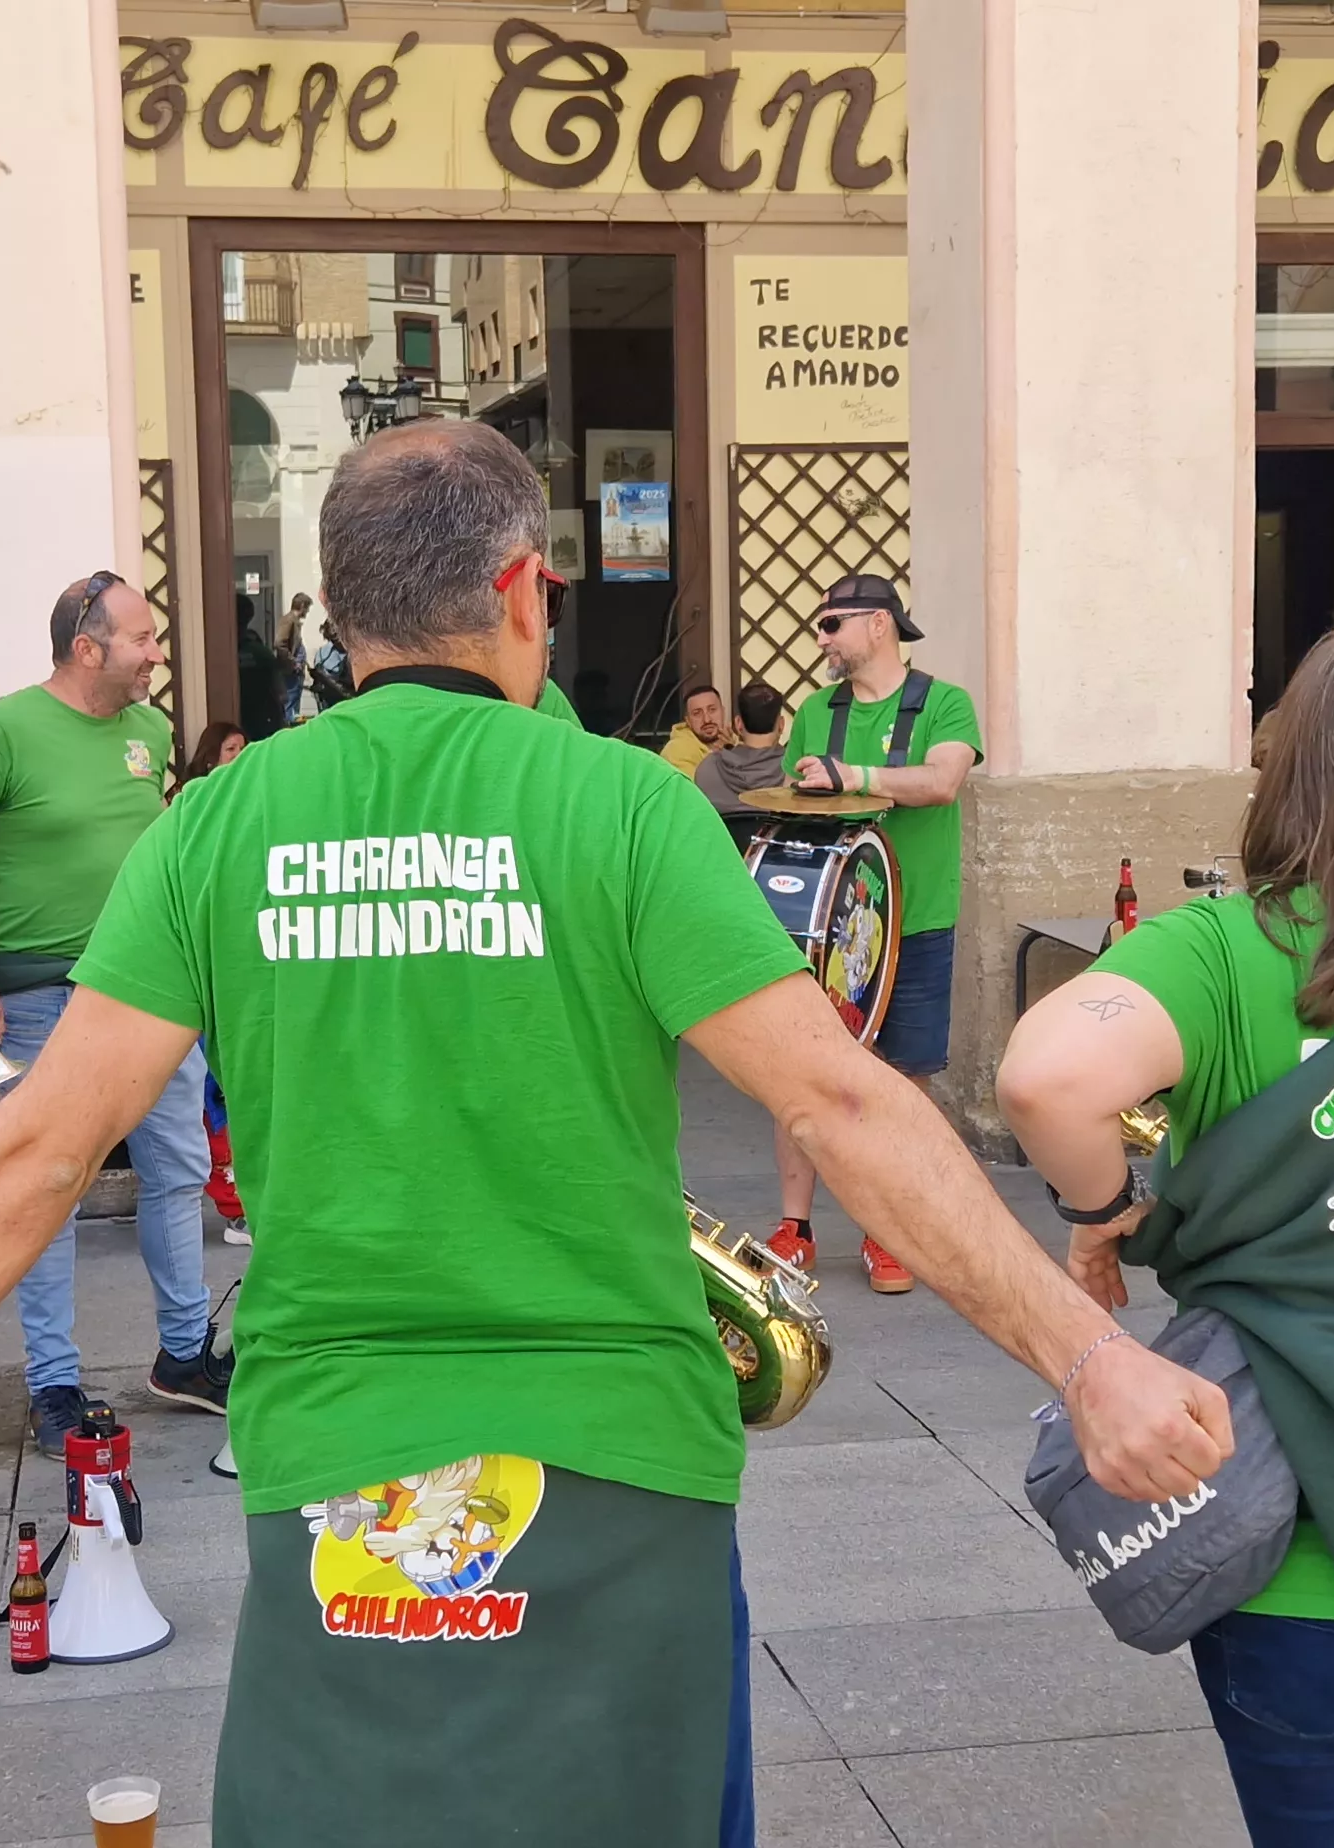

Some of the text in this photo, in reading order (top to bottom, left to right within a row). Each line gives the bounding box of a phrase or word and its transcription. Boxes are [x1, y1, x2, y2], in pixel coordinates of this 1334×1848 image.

[118, 31, 420, 191] Café
[486, 18, 907, 191] Can
[750, 278, 790, 306] TE
[765, 359, 900, 390] AMANDO
[639, 489, 665, 499] 2025
[267, 832, 520, 896] CHARANGA
[257, 892, 545, 961] CHILINDRÓN
[325, 1591, 525, 1640] CHILINDRON
